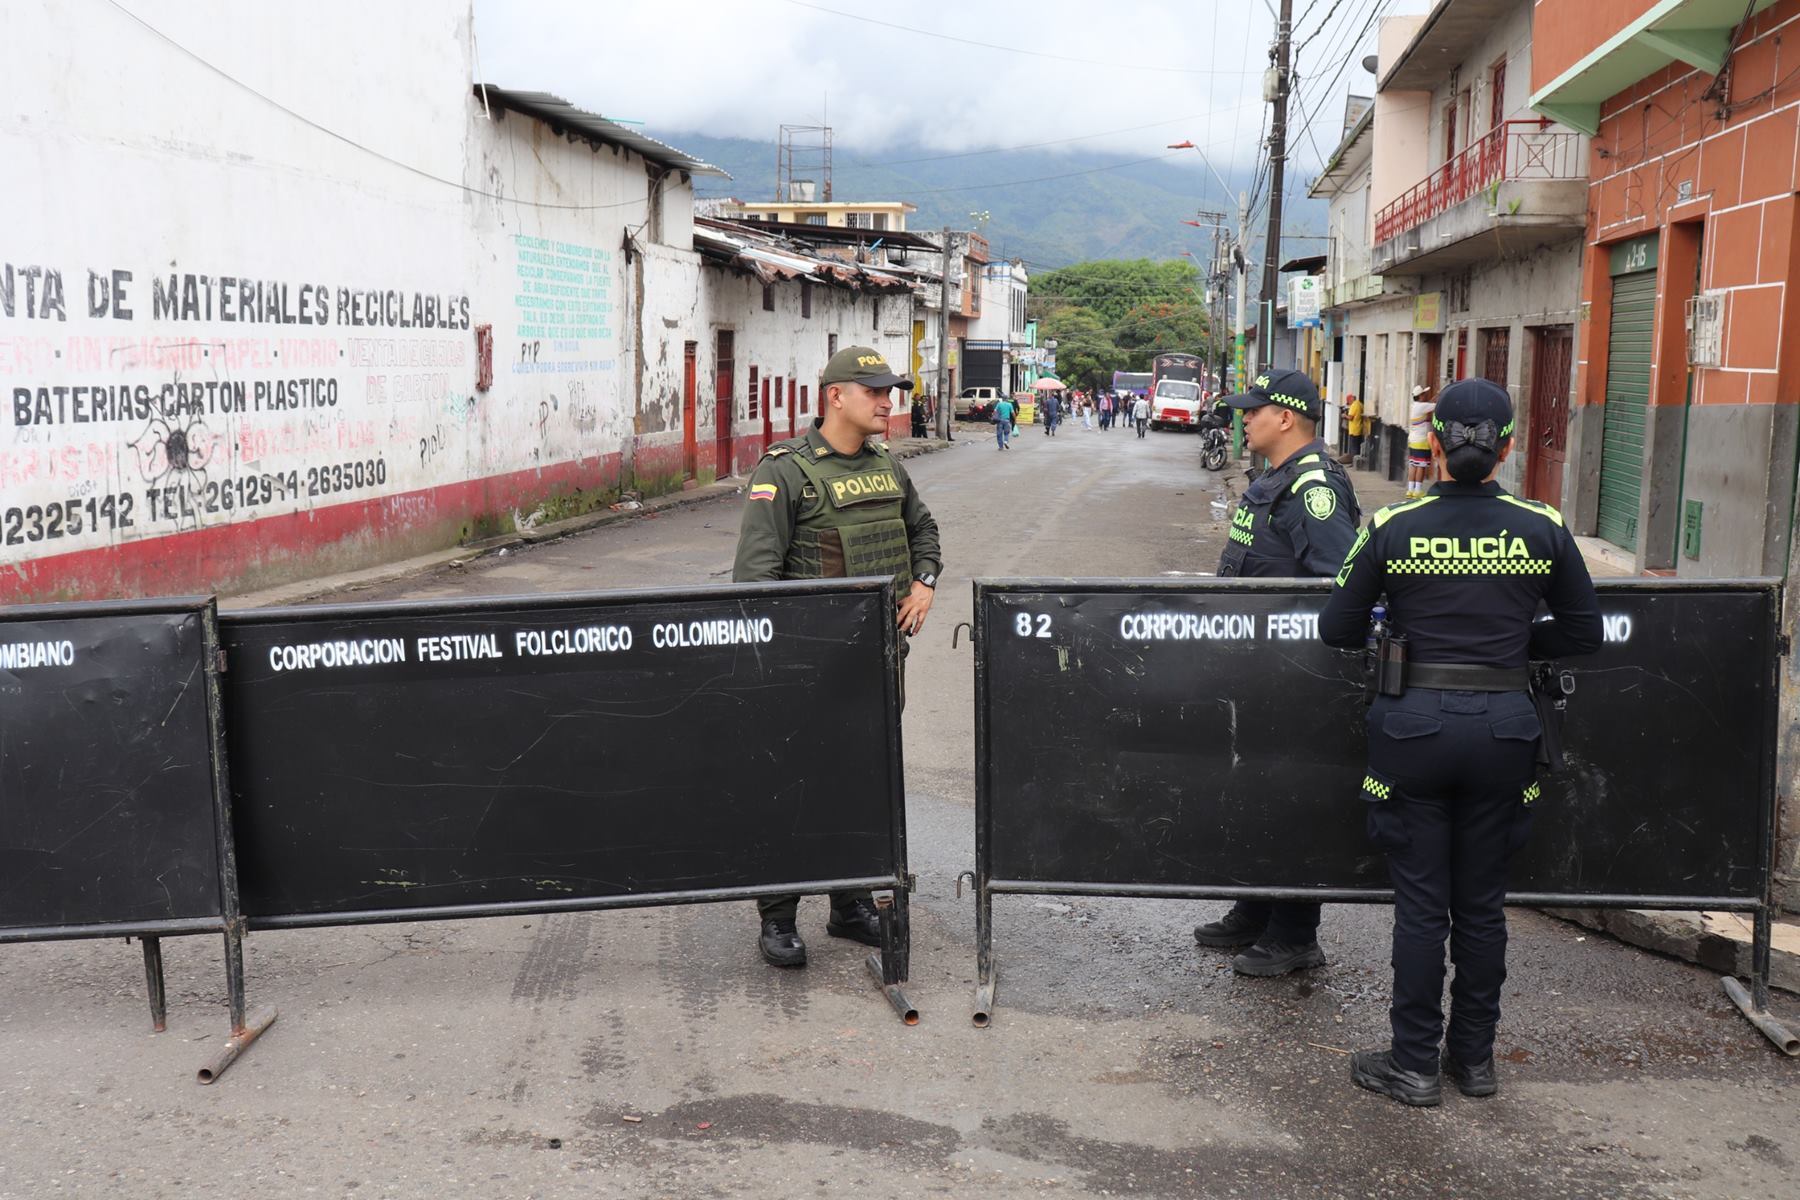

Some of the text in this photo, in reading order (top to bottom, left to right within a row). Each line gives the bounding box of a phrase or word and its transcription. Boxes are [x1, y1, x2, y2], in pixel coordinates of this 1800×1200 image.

[87, 267, 133, 320] DE
[153, 274, 329, 325] MATERIALES
[337, 285, 470, 330] RECICLABLES
[13, 378, 338, 426] BATERIAS CARTON PLASTICO
[0, 492, 134, 546] 2325142
[308, 458, 386, 497] 2635030
[832, 473, 898, 500] POLICIA
[1410, 529, 1530, 559] POLICÍA
[270, 618, 774, 671] CORPORACION FESTIVAL FOLCLORICO COLOMBIANO
[1016, 613, 1319, 640] 82 CORPORACION FESTI
[0, 640, 74, 669] MBIANO
